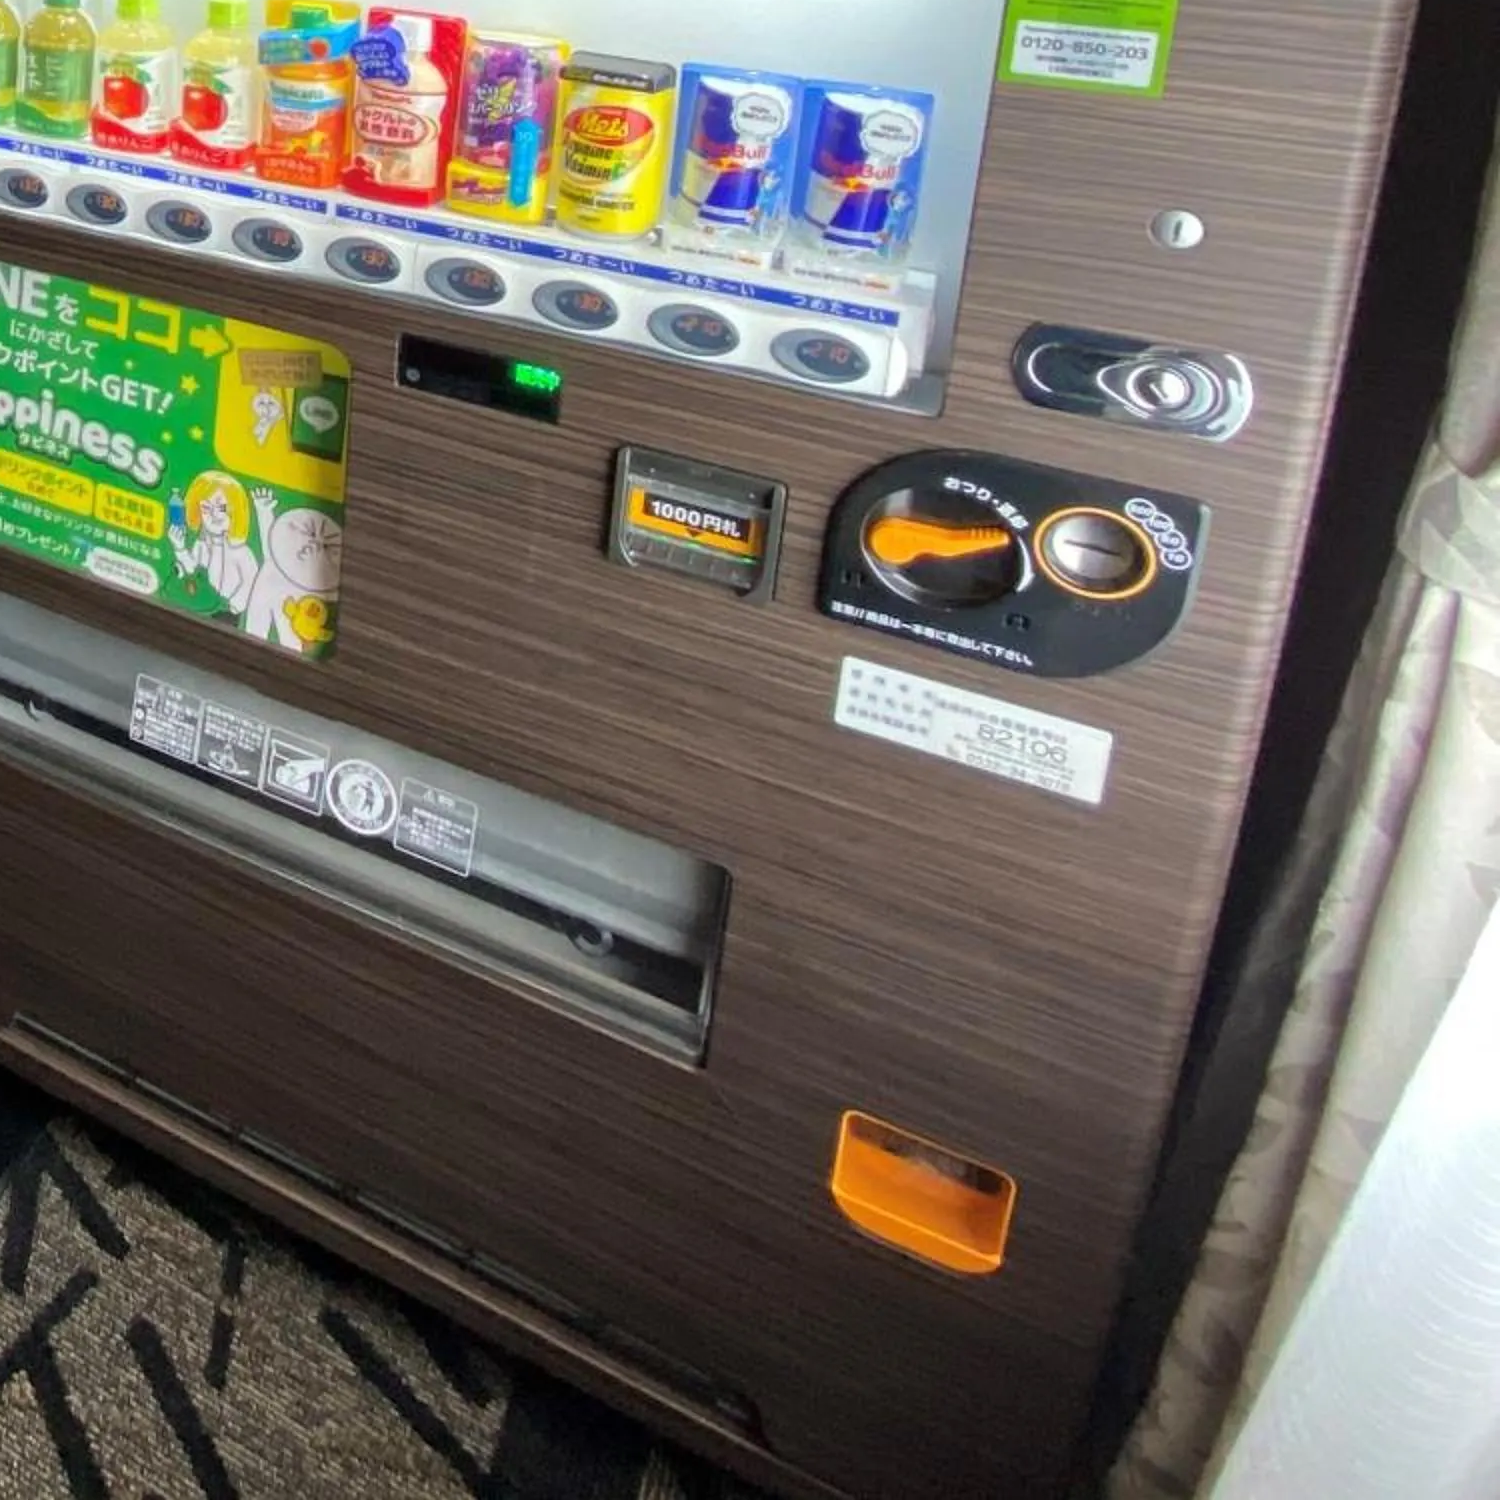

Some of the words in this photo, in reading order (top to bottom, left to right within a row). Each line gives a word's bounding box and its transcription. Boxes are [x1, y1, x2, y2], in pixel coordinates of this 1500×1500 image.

[1020, 34, 1150, 62] 0120-850-203
[733, 142, 768, 159] Bull
[861, 163, 897, 180] Bull
[8, 318, 98, 359] にかざして
[650, 498, 743, 541] 1000円札
[976, 721, 1068, 765] 82106
